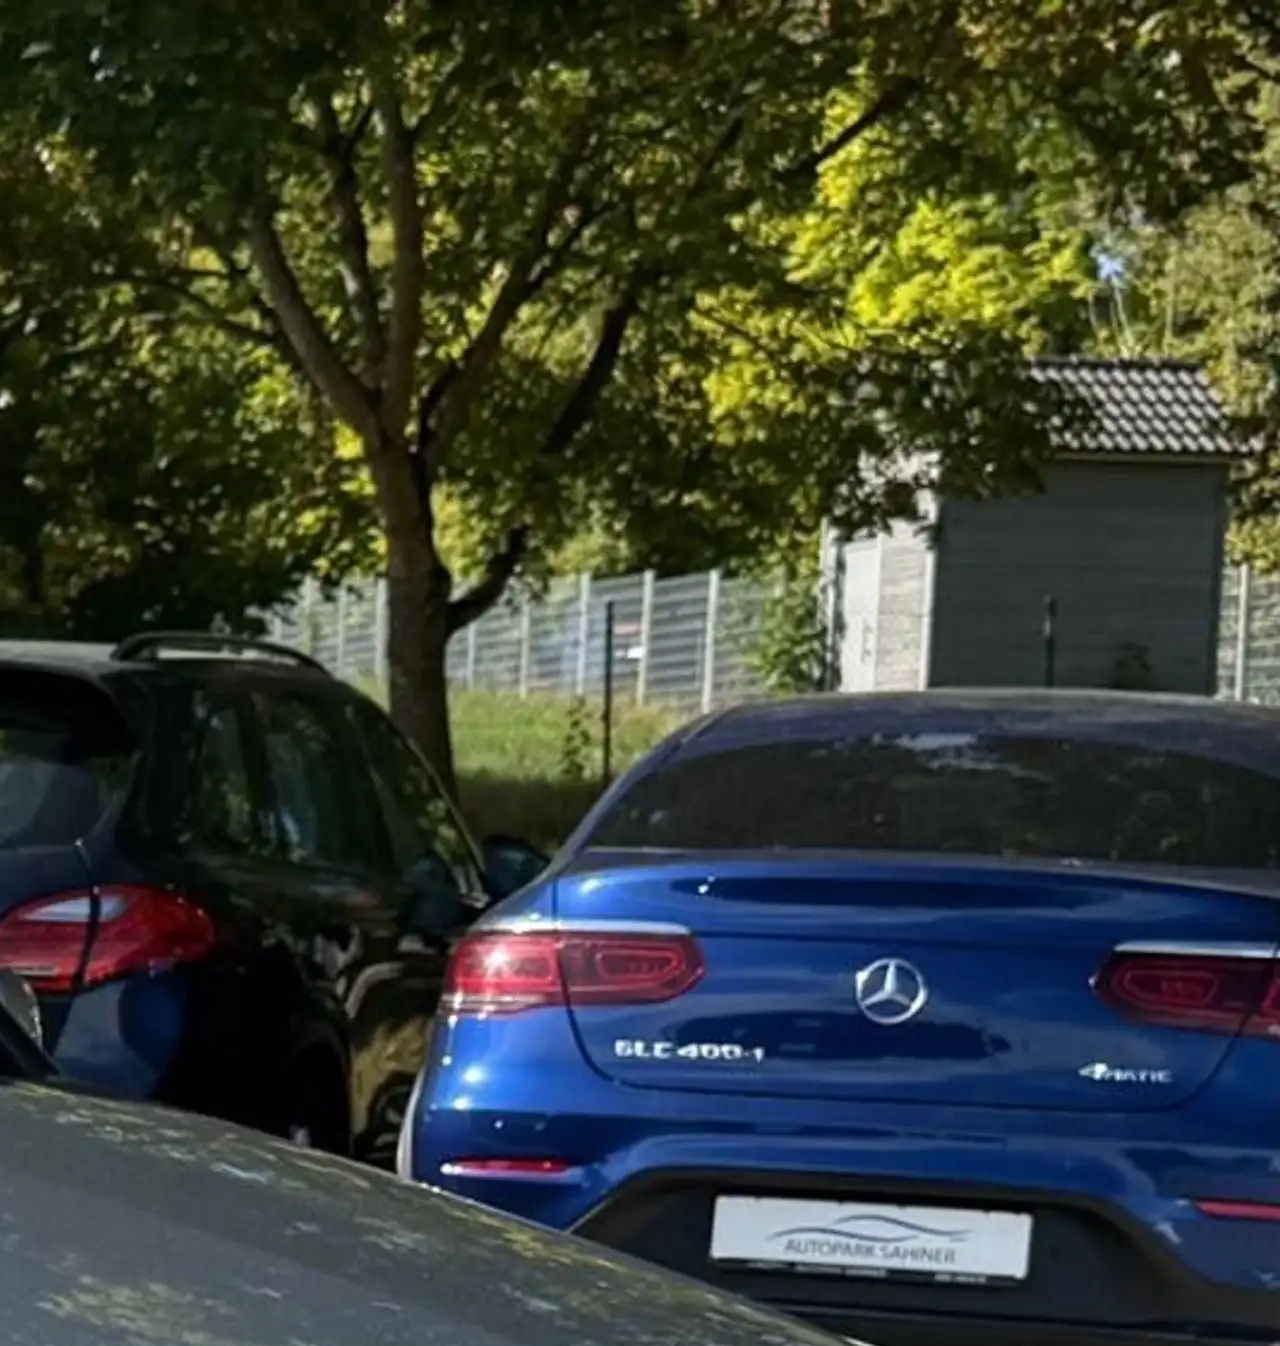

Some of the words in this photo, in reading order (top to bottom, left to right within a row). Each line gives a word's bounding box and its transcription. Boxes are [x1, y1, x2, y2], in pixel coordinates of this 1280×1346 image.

[676, 1043, 743, 1061] 400
[784, 1238, 876, 1260] AUTOPARK
[881, 1241, 957, 1265] SAHINER
